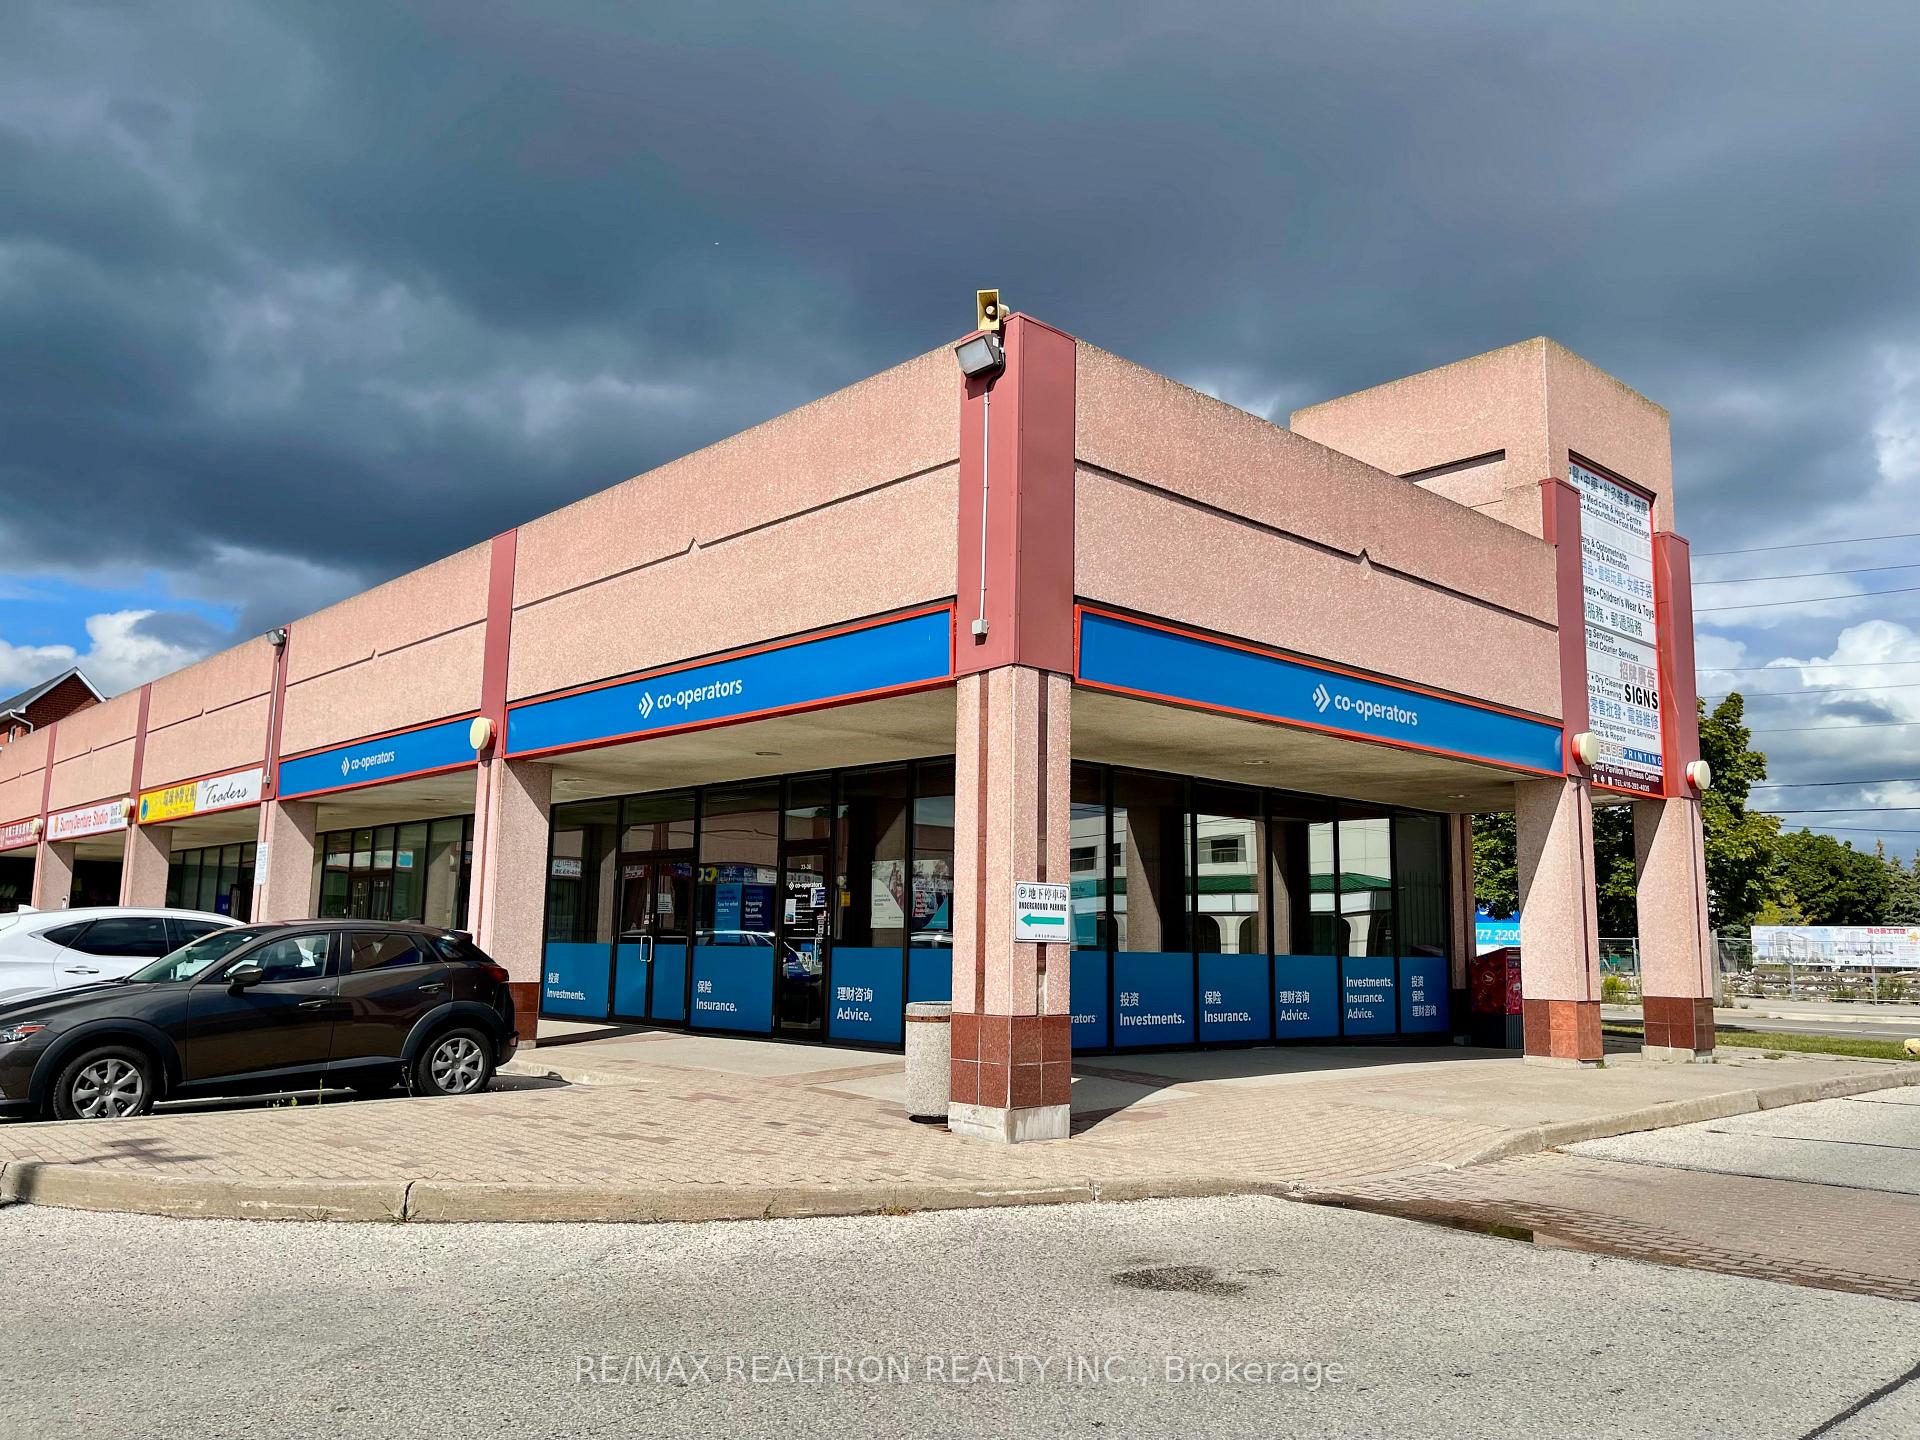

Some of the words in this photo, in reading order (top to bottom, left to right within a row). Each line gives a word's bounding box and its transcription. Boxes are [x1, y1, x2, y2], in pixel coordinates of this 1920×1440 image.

[1587, 494, 1609, 511] Medicine
[1615, 508, 1625, 520] Herb
[1626, 513, 1642, 526] Centre
[1642, 604, 1654, 620] Toys
[1593, 628, 1614, 644] Services
[1619, 648, 1638, 661] Services
[657, 679, 742, 710] co-operators
[1624, 683, 1658, 709] SIGNS
[1334, 694, 1418, 726] co-operators
[1637, 729, 1656, 740] Services
[351, 751, 395, 771] co-operators
[1624, 748, 1661, 765] PRINTING
[205, 782, 248, 805] Traders
[1018, 902, 1048, 911] UNDERGROUND
[1049, 903, 1067, 912] PARKING
[548, 972, 560, 984] 投资
[1346, 976, 1394, 988] Investments.
[1411, 975, 1424, 988] 投资
[546, 987, 586, 1001] Investments.
[697, 980, 712, 994] 保险
[837, 986, 873, 1002] 理财咨询
[1120, 992, 1139, 1007] 投资
[1204, 991, 1222, 1004] 保险
[1280, 990, 1310, 1004] 理财咨询
[1346, 992, 1385, 1003] Insurance.
[1411, 990, 1424, 1002] 保险
[696, 998, 738, 1012] Insurance.
[1412, 1005, 1437, 1017] 理财咨询
[836, 1007, 872, 1021] Advice.
[1119, 1013, 1185, 1026] Investments.
[1204, 1010, 1251, 1023] Insurance.
[1280, 1009, 1310, 1021] Advice.
[1347, 1008, 1375, 1019] Advice.
